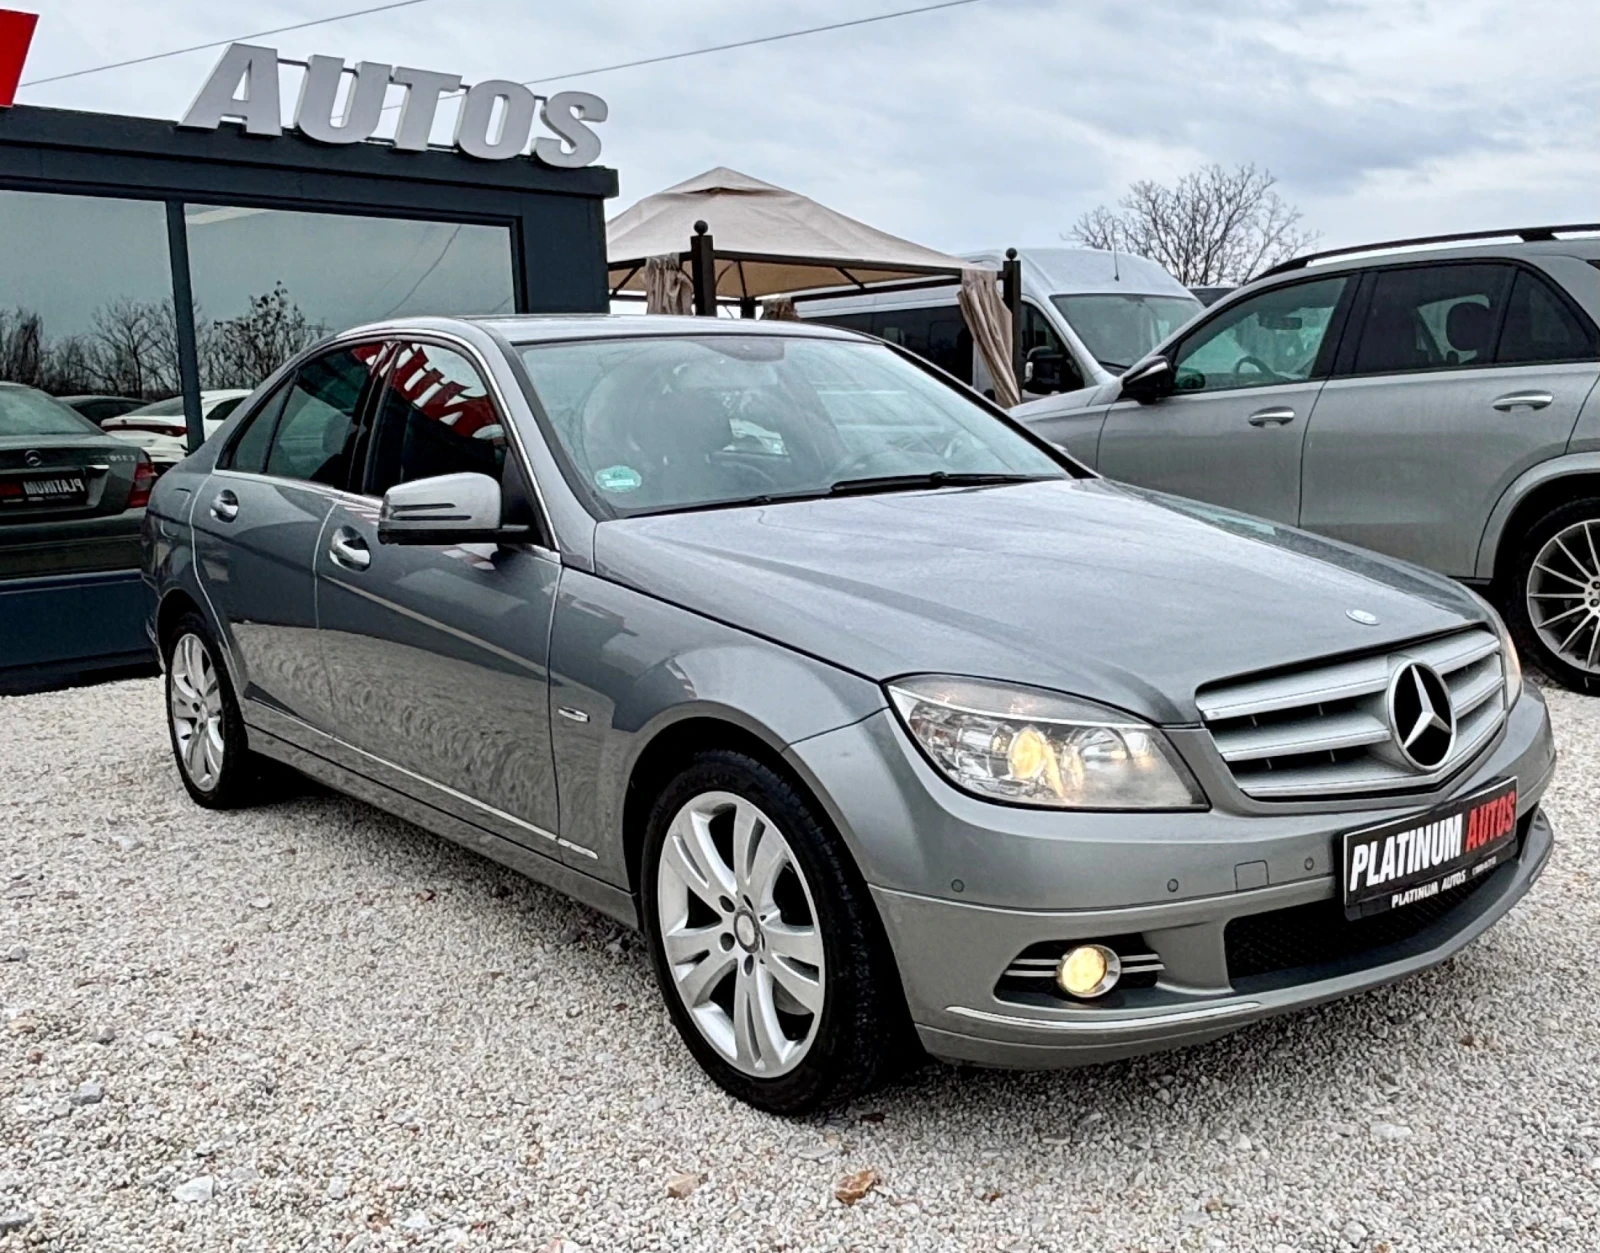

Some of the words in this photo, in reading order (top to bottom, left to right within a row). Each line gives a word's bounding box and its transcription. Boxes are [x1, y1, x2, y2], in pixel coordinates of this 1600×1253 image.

[178, 42, 609, 168] AUTOS
[1349, 813, 1463, 892] PLATINUM
[1465, 790, 1516, 853] AUTOS
[1391, 881, 1439, 908] PLATINUM
[1441, 869, 1467, 892] AUTOS
